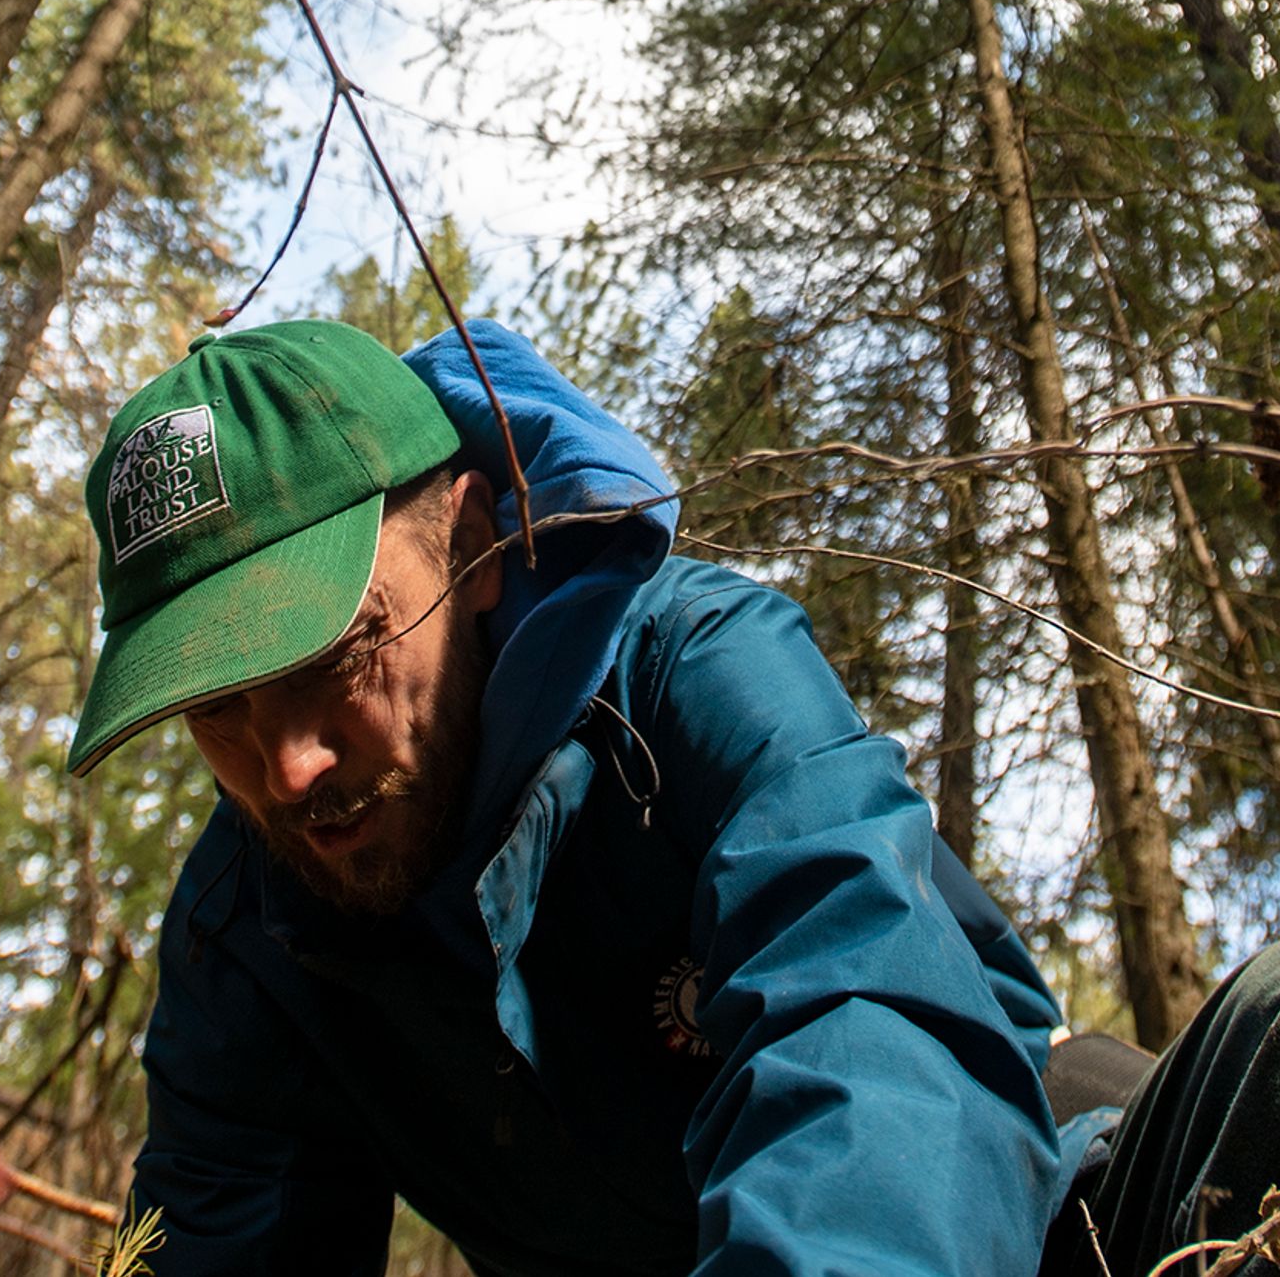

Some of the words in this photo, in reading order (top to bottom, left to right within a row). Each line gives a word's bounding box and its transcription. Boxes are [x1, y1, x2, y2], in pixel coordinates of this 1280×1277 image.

[110, 434, 213, 504] PALOUSE
[127, 466, 194, 517] LAND
[124, 481, 202, 539] TRUST
[654, 957, 695, 1030] AMERIC
